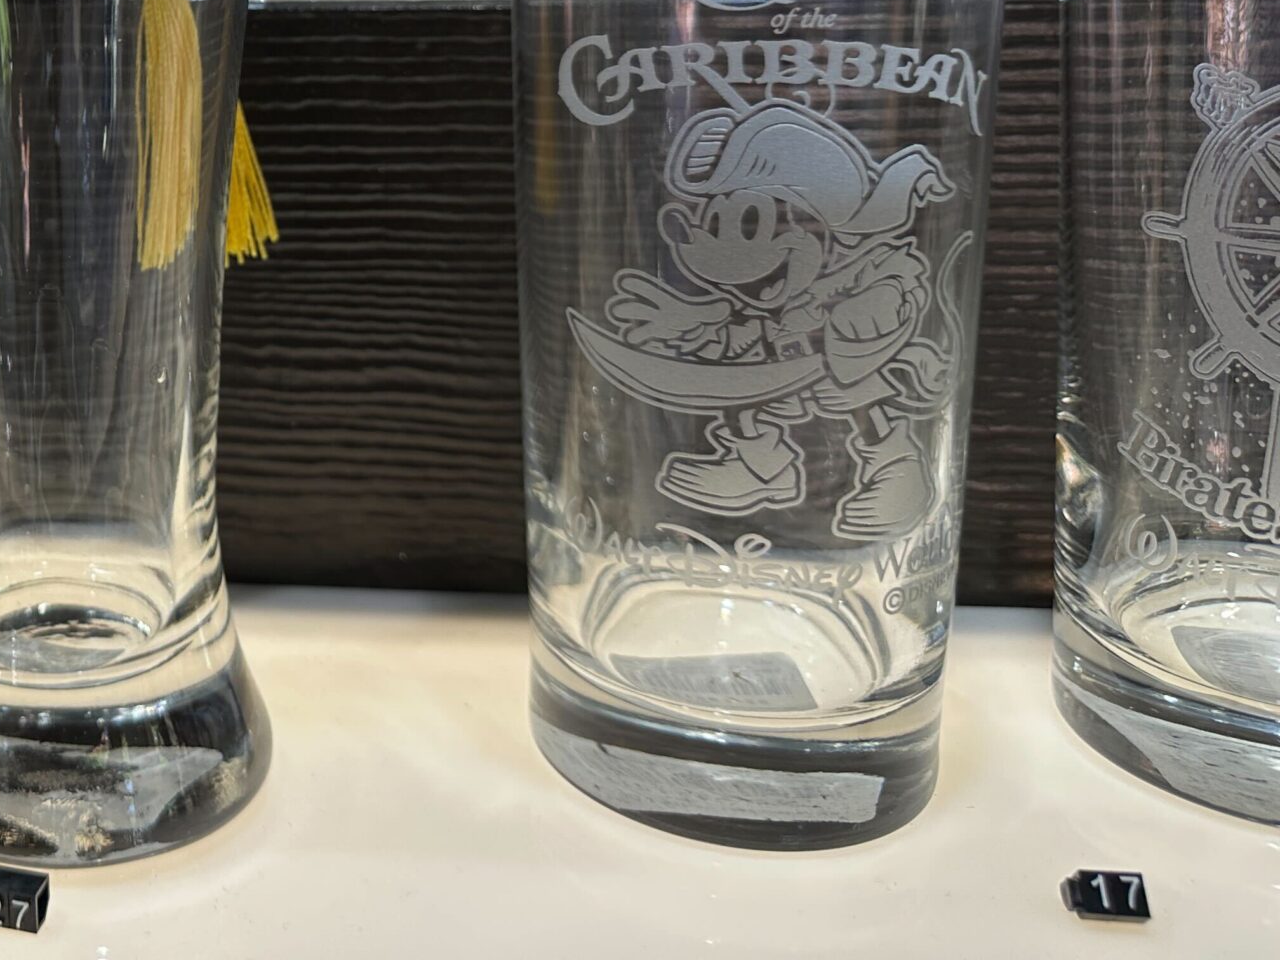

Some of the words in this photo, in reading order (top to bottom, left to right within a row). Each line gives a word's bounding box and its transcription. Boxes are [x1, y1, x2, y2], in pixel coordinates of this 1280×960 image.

[770, 6, 802, 35] of
[801, 6, 837, 28] the
[558, 34, 987, 137] CARIBBEAN
[1117, 408, 1280, 544] Pirate
[1089, 873, 1140, 911] 17
